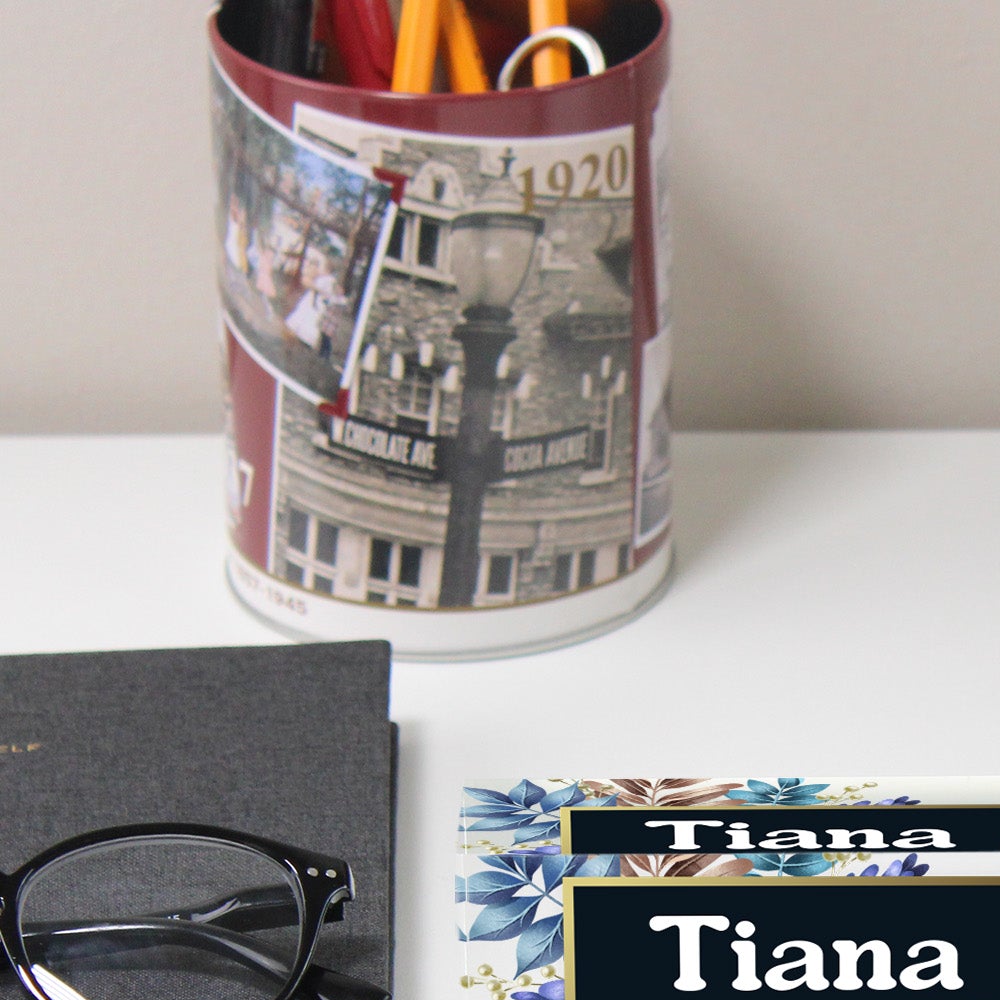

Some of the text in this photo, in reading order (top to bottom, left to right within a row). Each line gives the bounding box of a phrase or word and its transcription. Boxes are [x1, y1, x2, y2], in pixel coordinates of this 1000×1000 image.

[518, 144, 629, 214] 1920
[343, 419, 411, 465] CHOCOLATE
[410, 438, 438, 470] AVE
[645, 818, 957, 851] Tiana
[650, 914, 964, 992] Tiana
